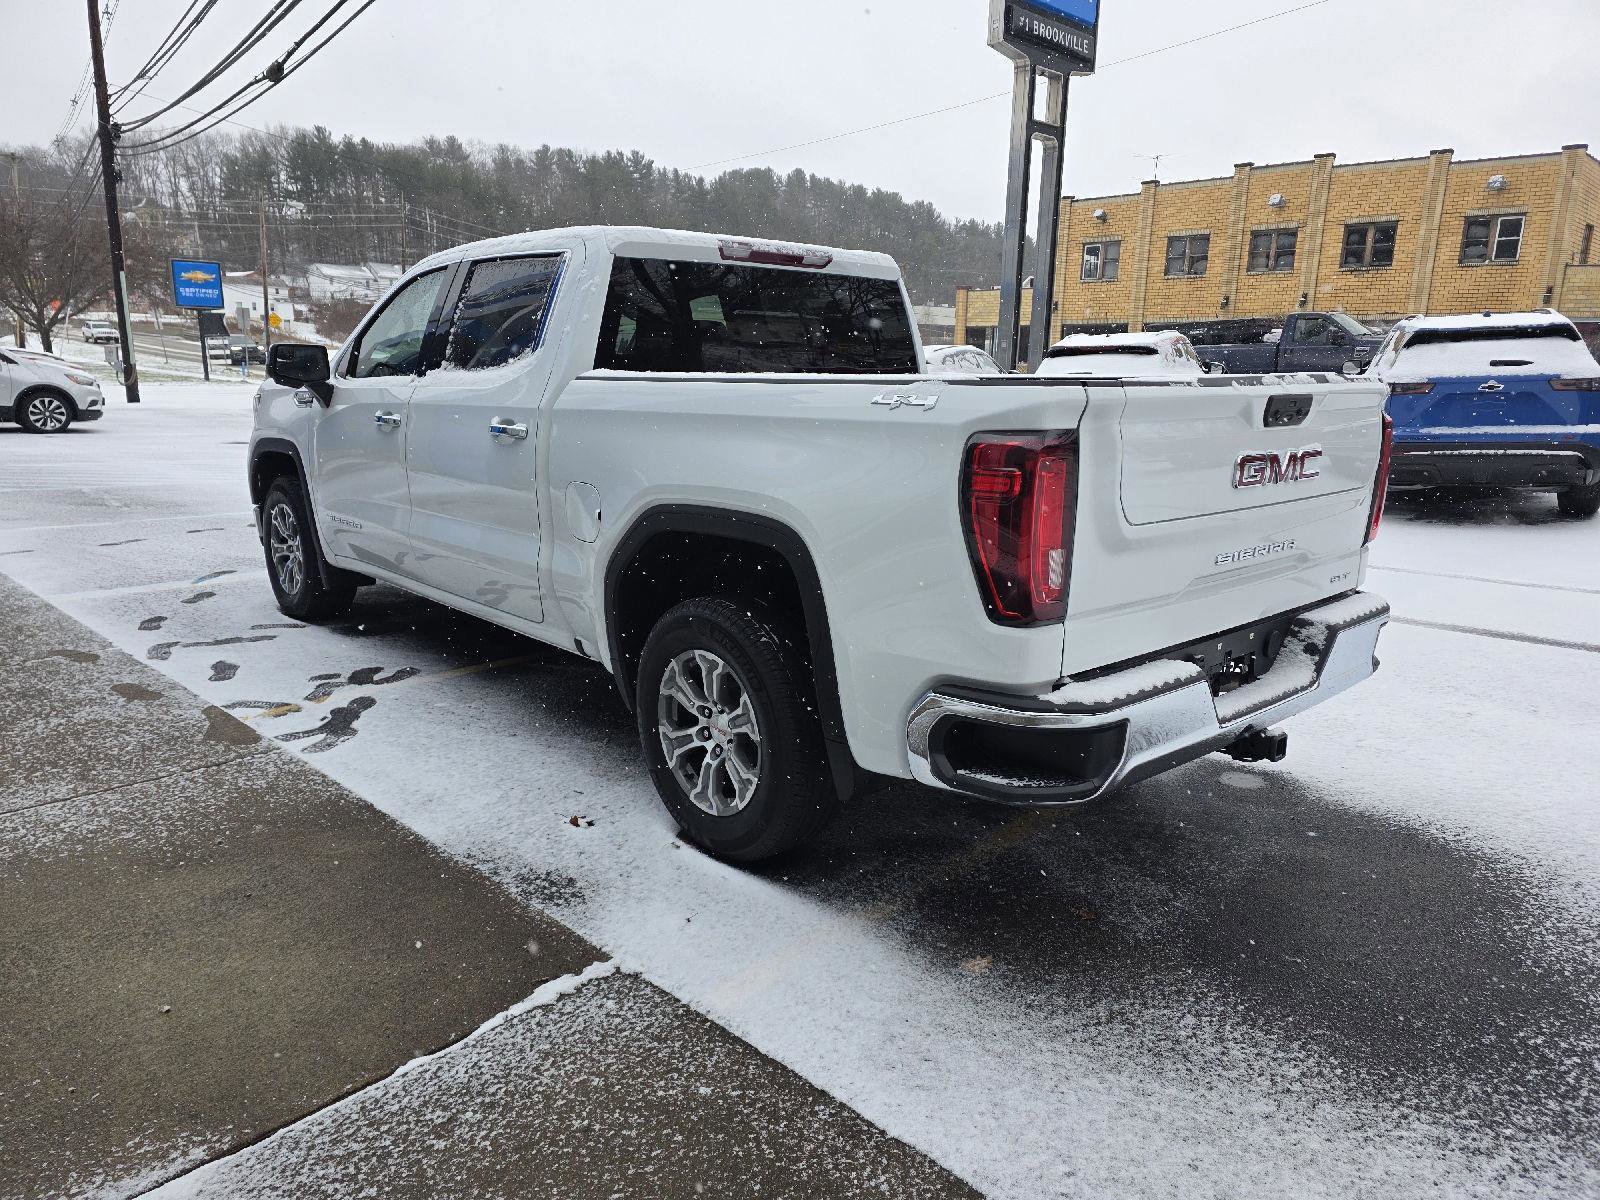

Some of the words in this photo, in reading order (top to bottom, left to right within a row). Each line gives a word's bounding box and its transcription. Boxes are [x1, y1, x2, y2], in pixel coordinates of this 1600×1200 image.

[1033, 20, 1089, 54] BROOKVILLE
[1232, 447, 1322, 489] GMC
[1214, 539, 1297, 566] SIERRA
